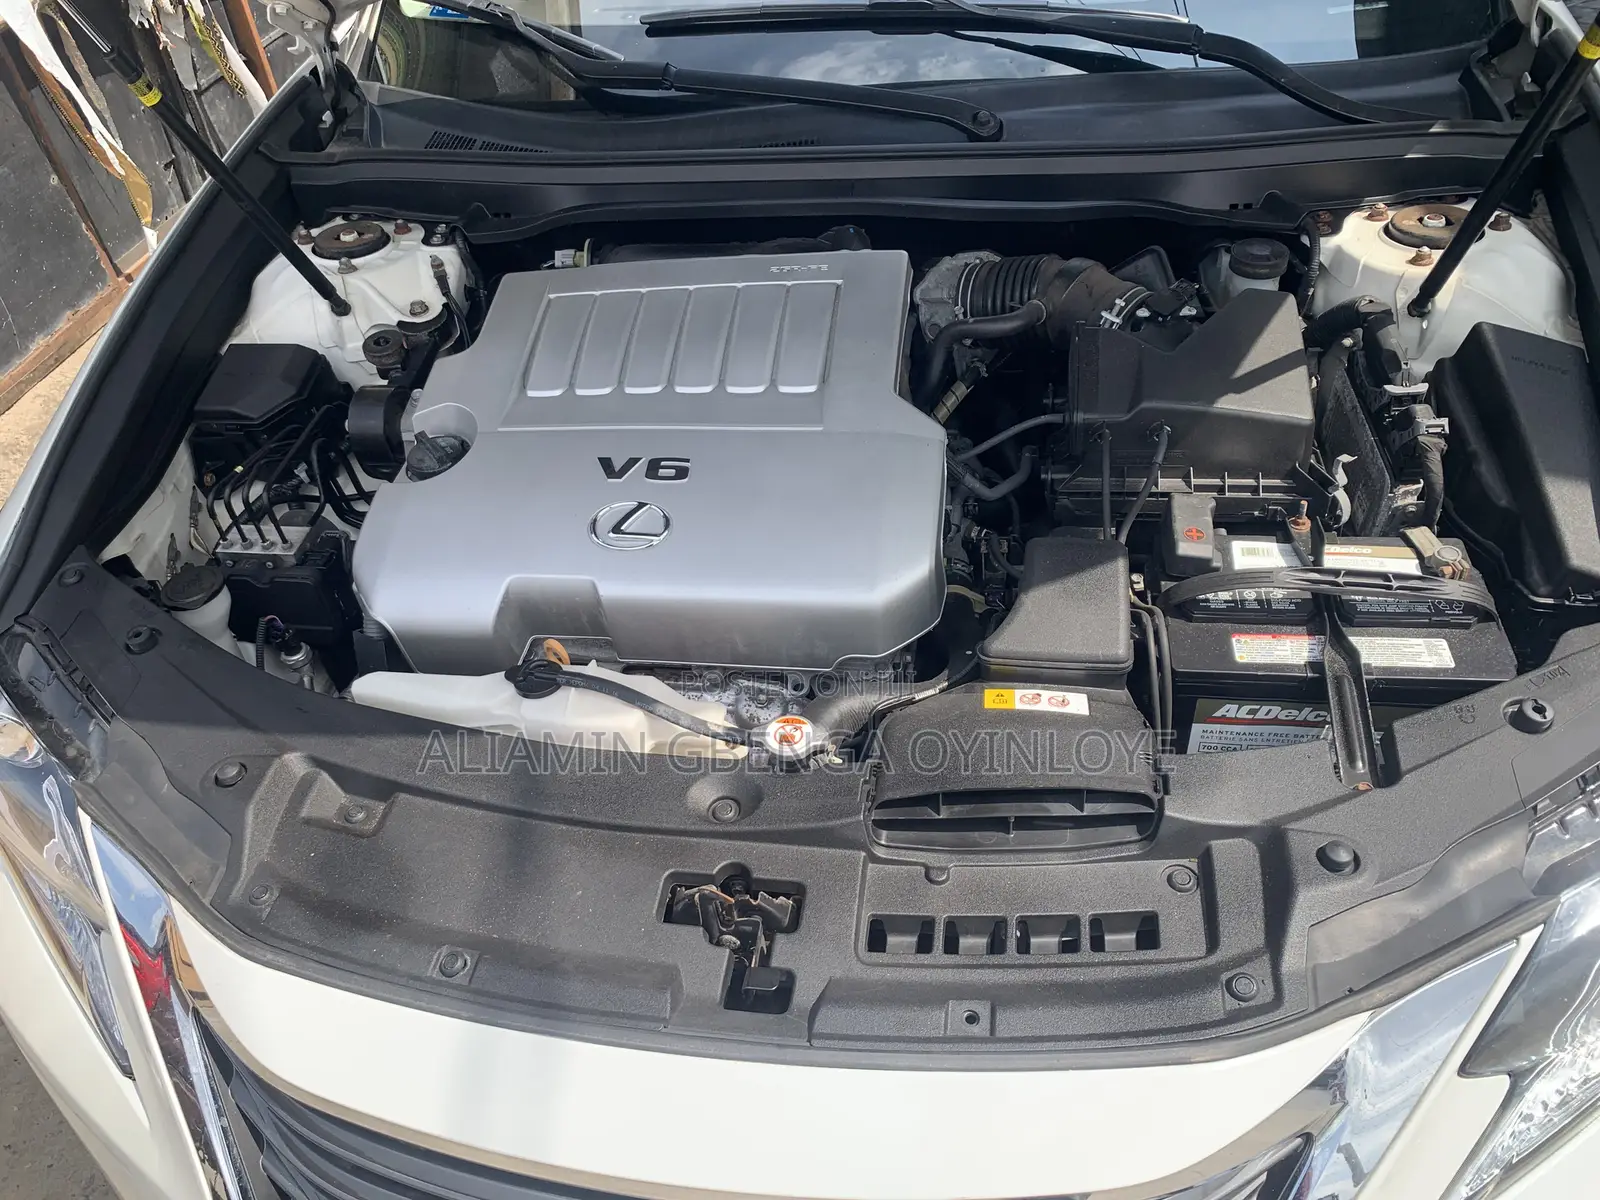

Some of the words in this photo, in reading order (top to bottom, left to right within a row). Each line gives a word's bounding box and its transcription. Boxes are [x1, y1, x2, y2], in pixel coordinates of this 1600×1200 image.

[597, 456, 691, 482] V6
[1212, 703, 1332, 723] ACDelc
[1201, 729, 1265, 737] MAINTENANCE
